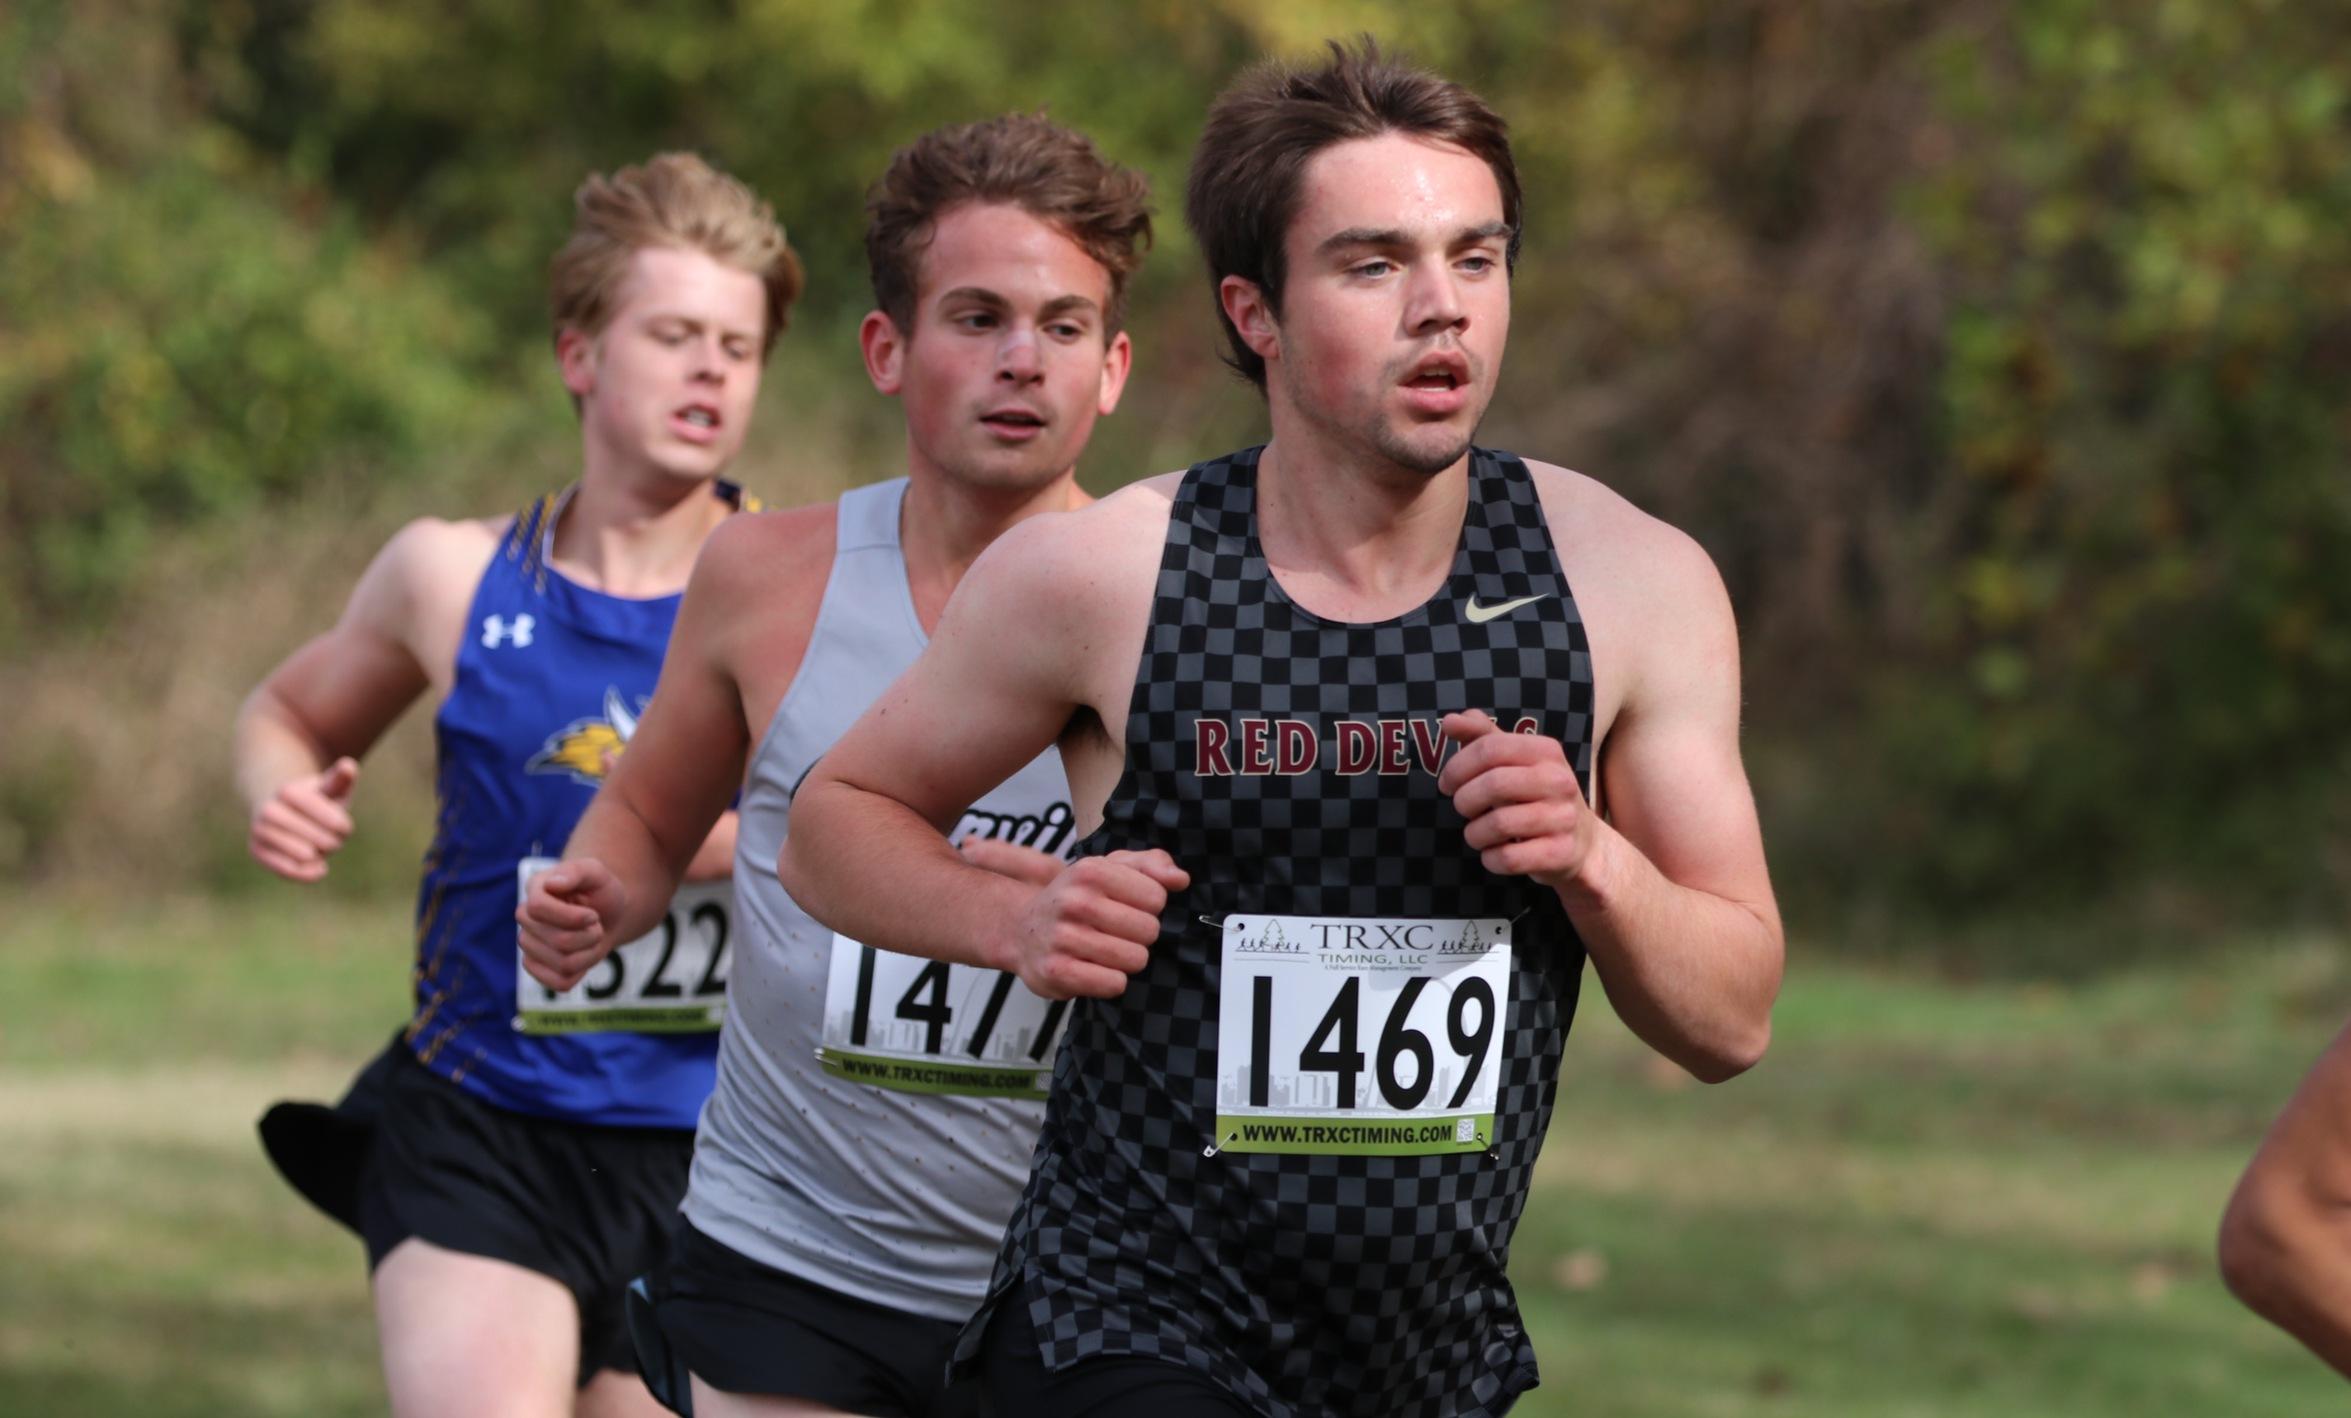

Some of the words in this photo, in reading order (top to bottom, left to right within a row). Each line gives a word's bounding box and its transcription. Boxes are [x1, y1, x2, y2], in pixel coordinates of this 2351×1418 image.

[1194, 718, 1318, 777] RED
[1310, 924, 1434, 950] TRXC
[1317, 953, 1392, 966] TIMING,
[1399, 954, 1428, 965] LLC
[1249, 975, 1496, 1111] 1469
[842, 1058, 1032, 1089] WWW.TRXCTIMING.COM
[1242, 1124, 1453, 1145] WWW.TRXCTIMING.COM
